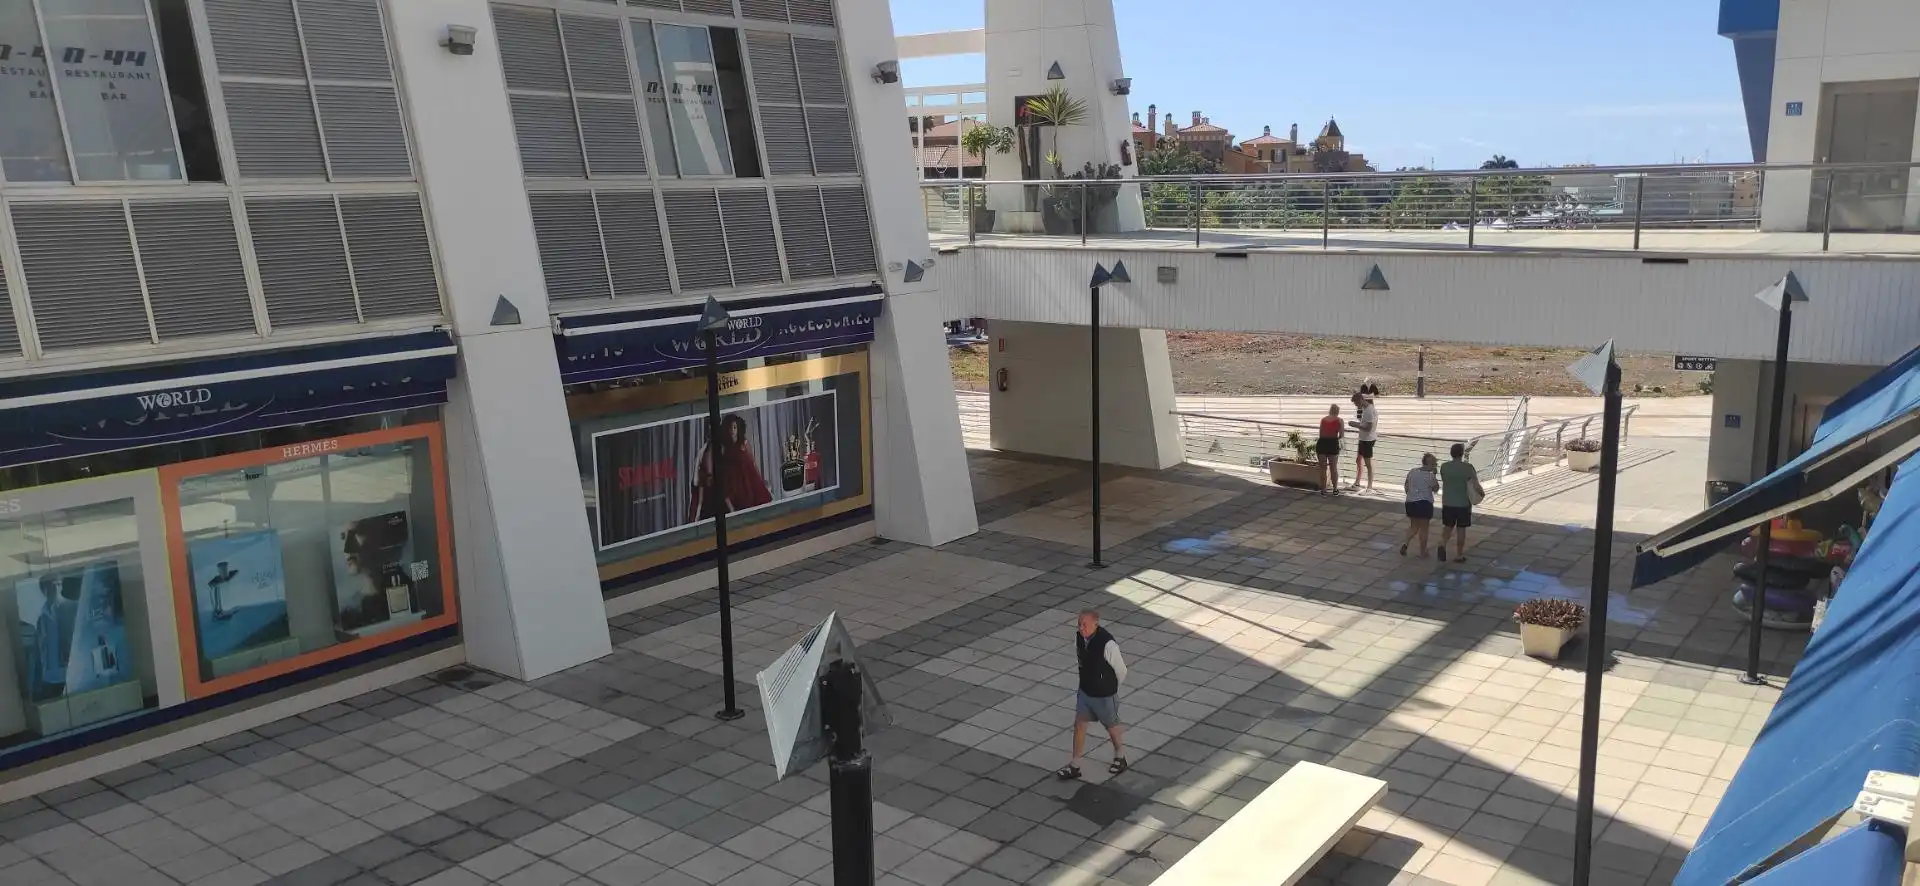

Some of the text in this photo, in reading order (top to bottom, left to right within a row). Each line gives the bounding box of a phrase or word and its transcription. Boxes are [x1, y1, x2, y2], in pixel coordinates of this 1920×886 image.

[65, 69, 151, 79] RESTAURANT
[101, 92, 127, 100] BAR
[728, 316, 762, 331] WORLD
[137, 388, 212, 412] WORLD
